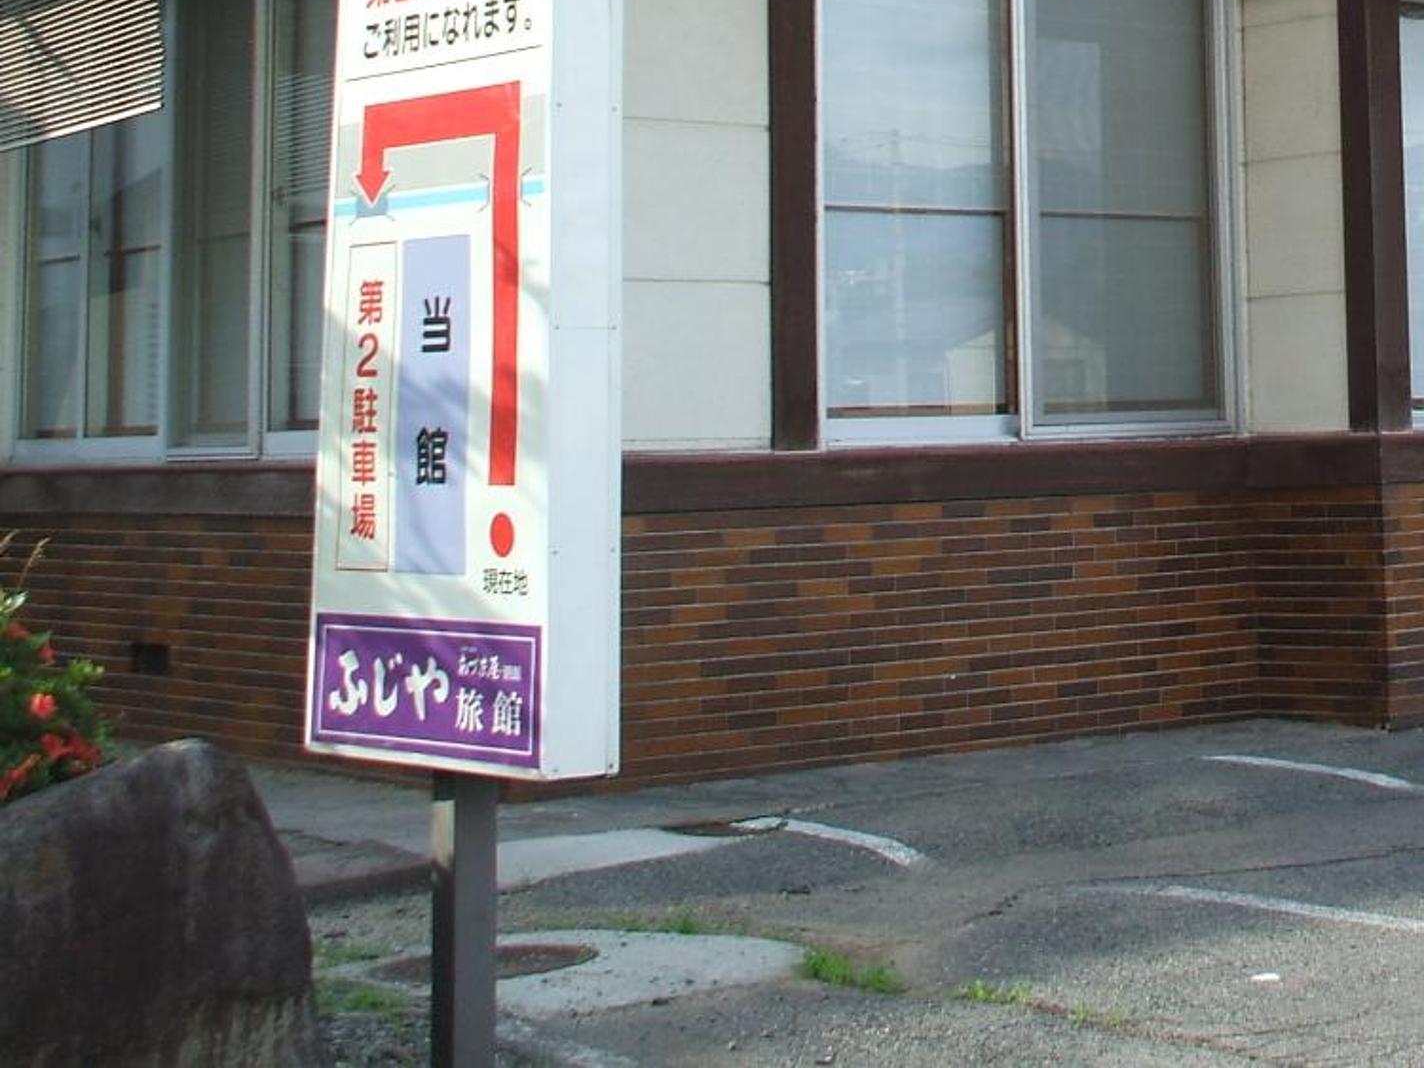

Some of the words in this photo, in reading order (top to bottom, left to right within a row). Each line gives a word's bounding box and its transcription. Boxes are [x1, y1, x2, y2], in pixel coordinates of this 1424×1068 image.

[351, 279, 384, 540] 第2駐車場
[416, 296, 452, 487] 当館
[482, 567, 528, 596] 現在地
[329, 649, 450, 722] ふじや
[455, 687, 523, 736] 旅館
